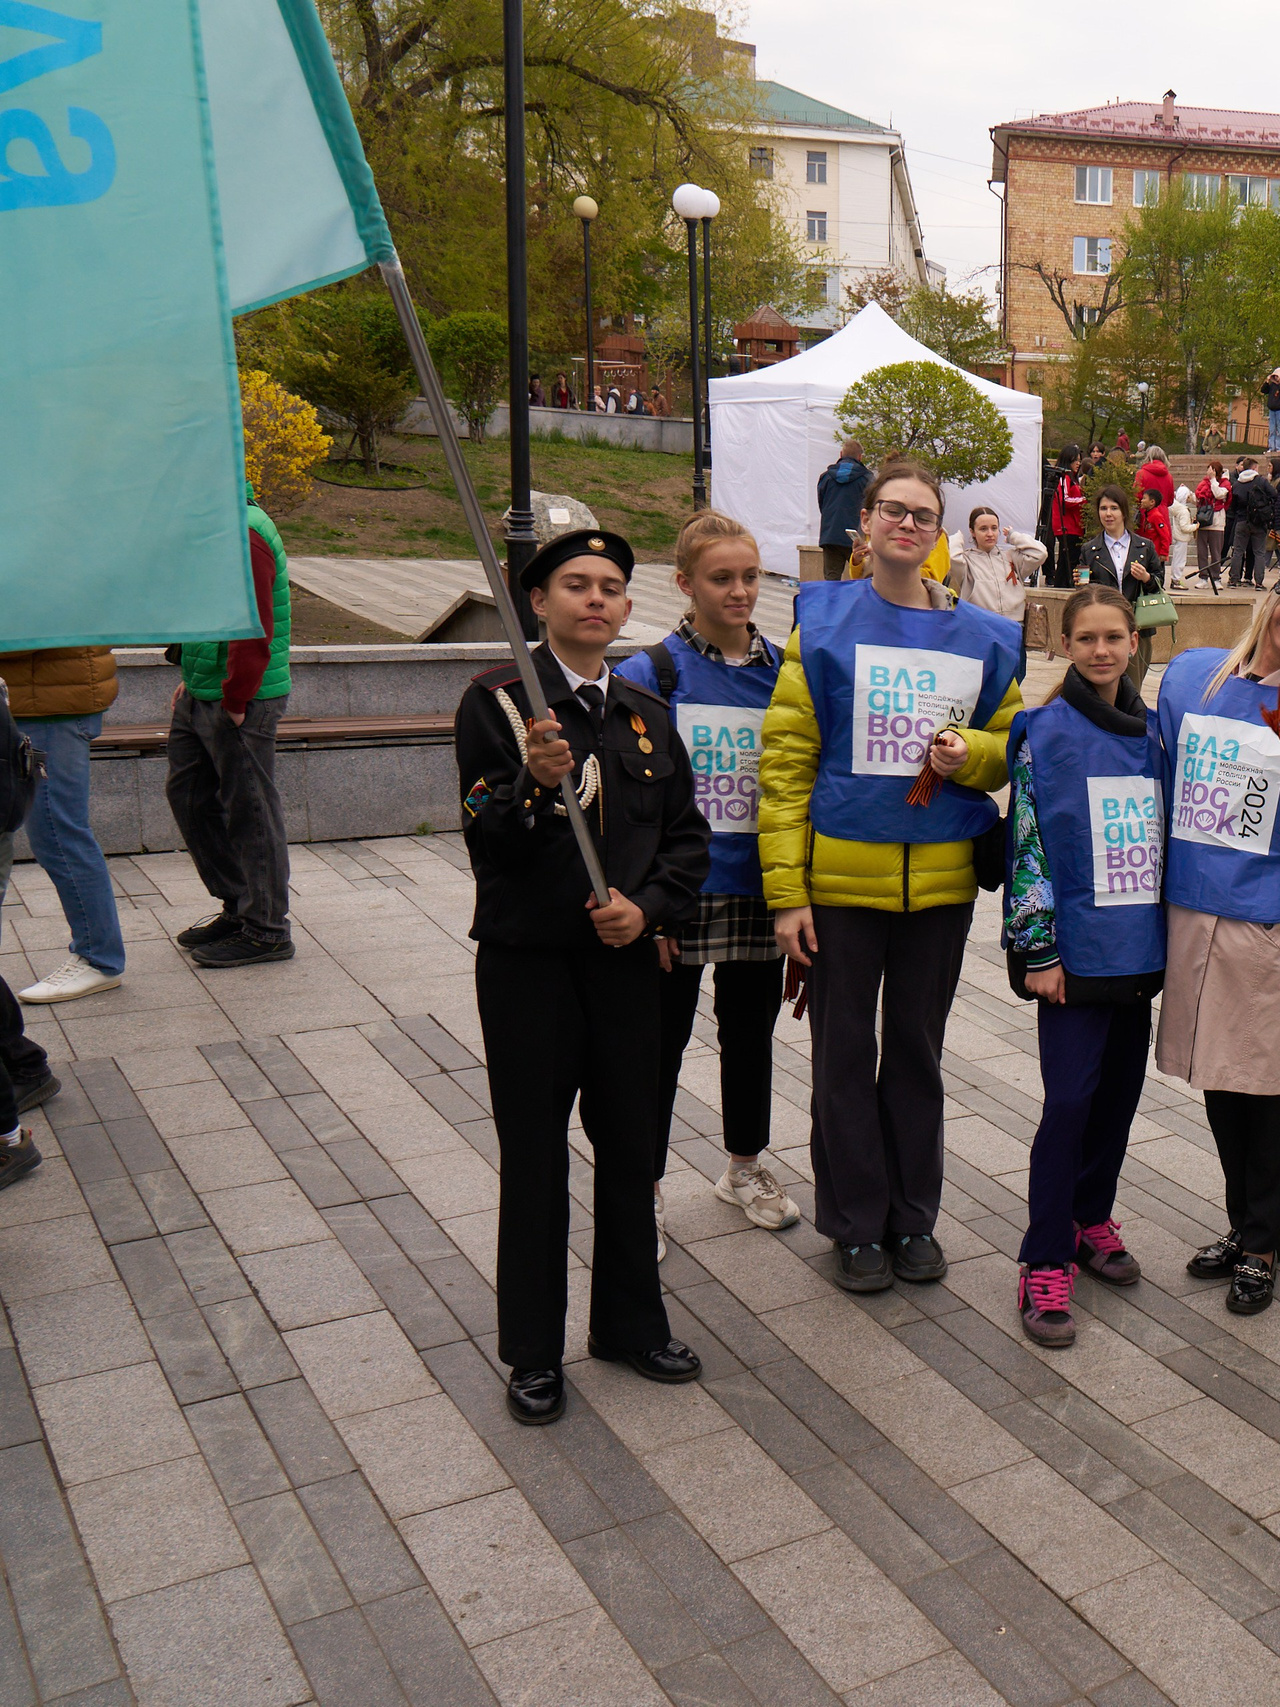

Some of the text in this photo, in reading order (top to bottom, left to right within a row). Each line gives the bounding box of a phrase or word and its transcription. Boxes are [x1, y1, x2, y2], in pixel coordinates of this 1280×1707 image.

[869, 665, 936, 692] вла
[918, 701, 949, 711] столица
[918, 708, 945, 718] России
[692, 725, 755, 749] вла
[868, 714, 935, 740] вос
[1186, 733, 1240, 761] вла
[694, 774, 757, 798] вос
[1216, 777, 1241, 787] России
[1218, 770, 1246, 780] столица
[1181, 781, 1230, 809] вос
[1238, 776, 1268, 838] 2024
[1102, 796, 1156, 820] вла
[1178, 804, 1239, 837] ток
[1106, 845, 1158, 869] вос
